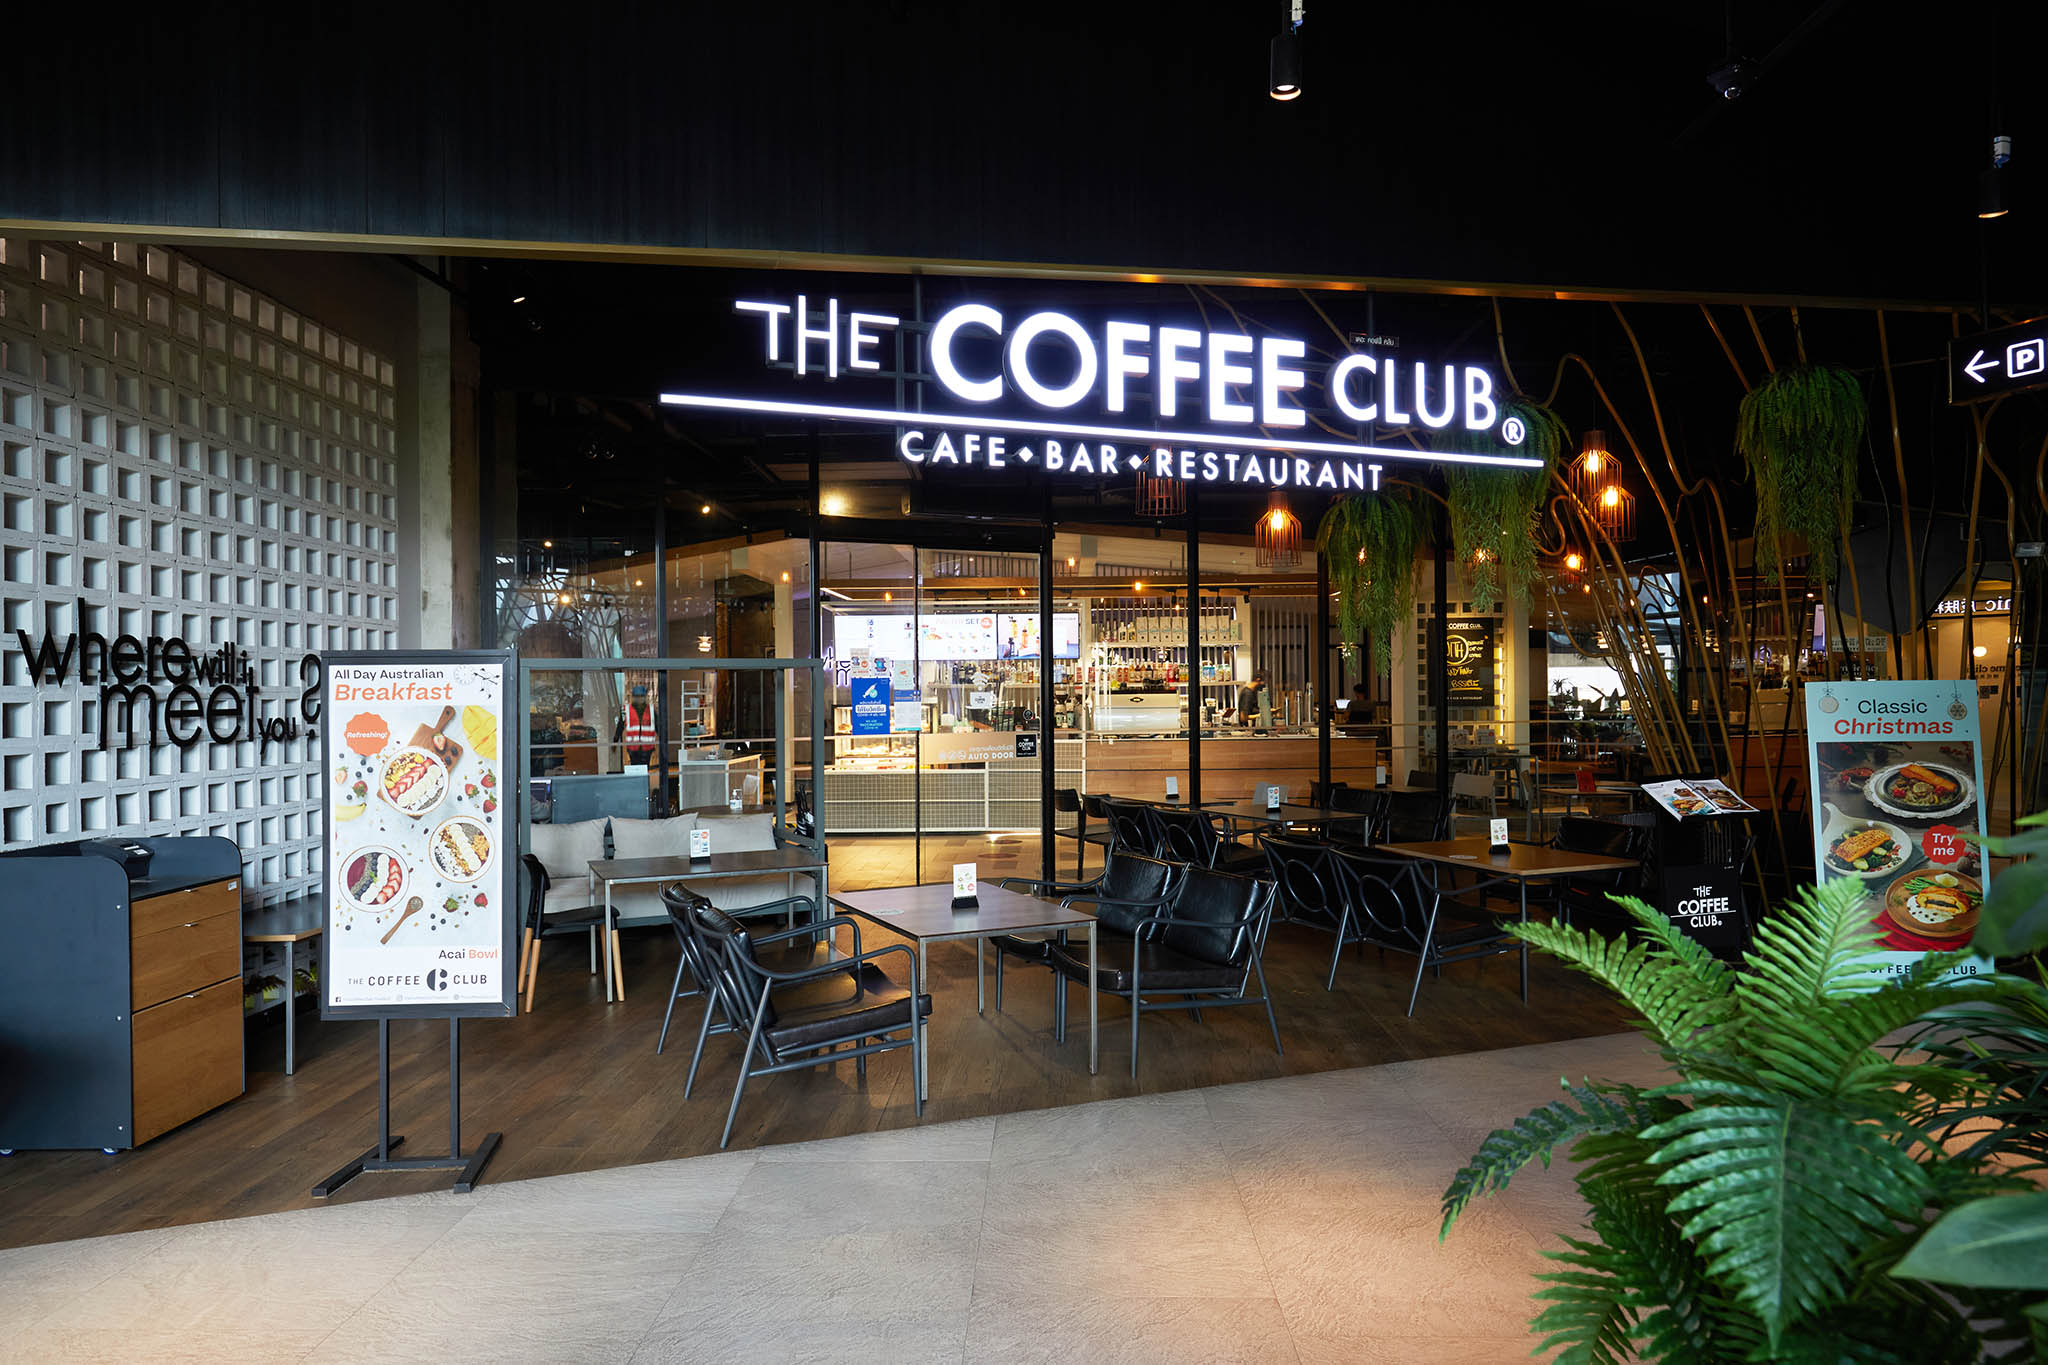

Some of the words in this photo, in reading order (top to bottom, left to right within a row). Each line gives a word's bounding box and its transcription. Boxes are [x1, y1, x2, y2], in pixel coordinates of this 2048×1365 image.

[735, 295, 899, 378] THE
[930, 303, 1306, 427] COFFEE
[2016, 348, 2036, 370] P
[900, 431, 1006, 467] CAFE
[1046, 440, 1118, 474] BAR
[1155, 449, 1383, 491] RESTAURANT
[16, 597, 192, 689] where
[192, 641, 235, 687] will
[334, 669, 350, 679] All
[353, 669, 377, 681] Day
[379, 668, 444, 679] Australian
[335, 682, 453, 701] Breakfast
[100, 667, 259, 751] meet
[257, 717, 297, 754] you
[1857, 698, 1928, 714] Classic
[1834, 717, 1953, 735] Christmas
[968, 752, 989, 760] AUTO
[991, 752, 1014, 760] DOOR
[1932, 833, 1955, 846] Try
[1933, 847, 1955, 856] me
[1693, 885, 1713, 897] THE
[1678, 897, 1729, 915] COFFEE
[438, 949, 466, 959] Acai
[468, 949, 498, 959] Bowl
[1945, 965, 1977, 975] LUB
[368, 975, 420, 986] COFFEE
[453, 974, 488, 985] CLUB
